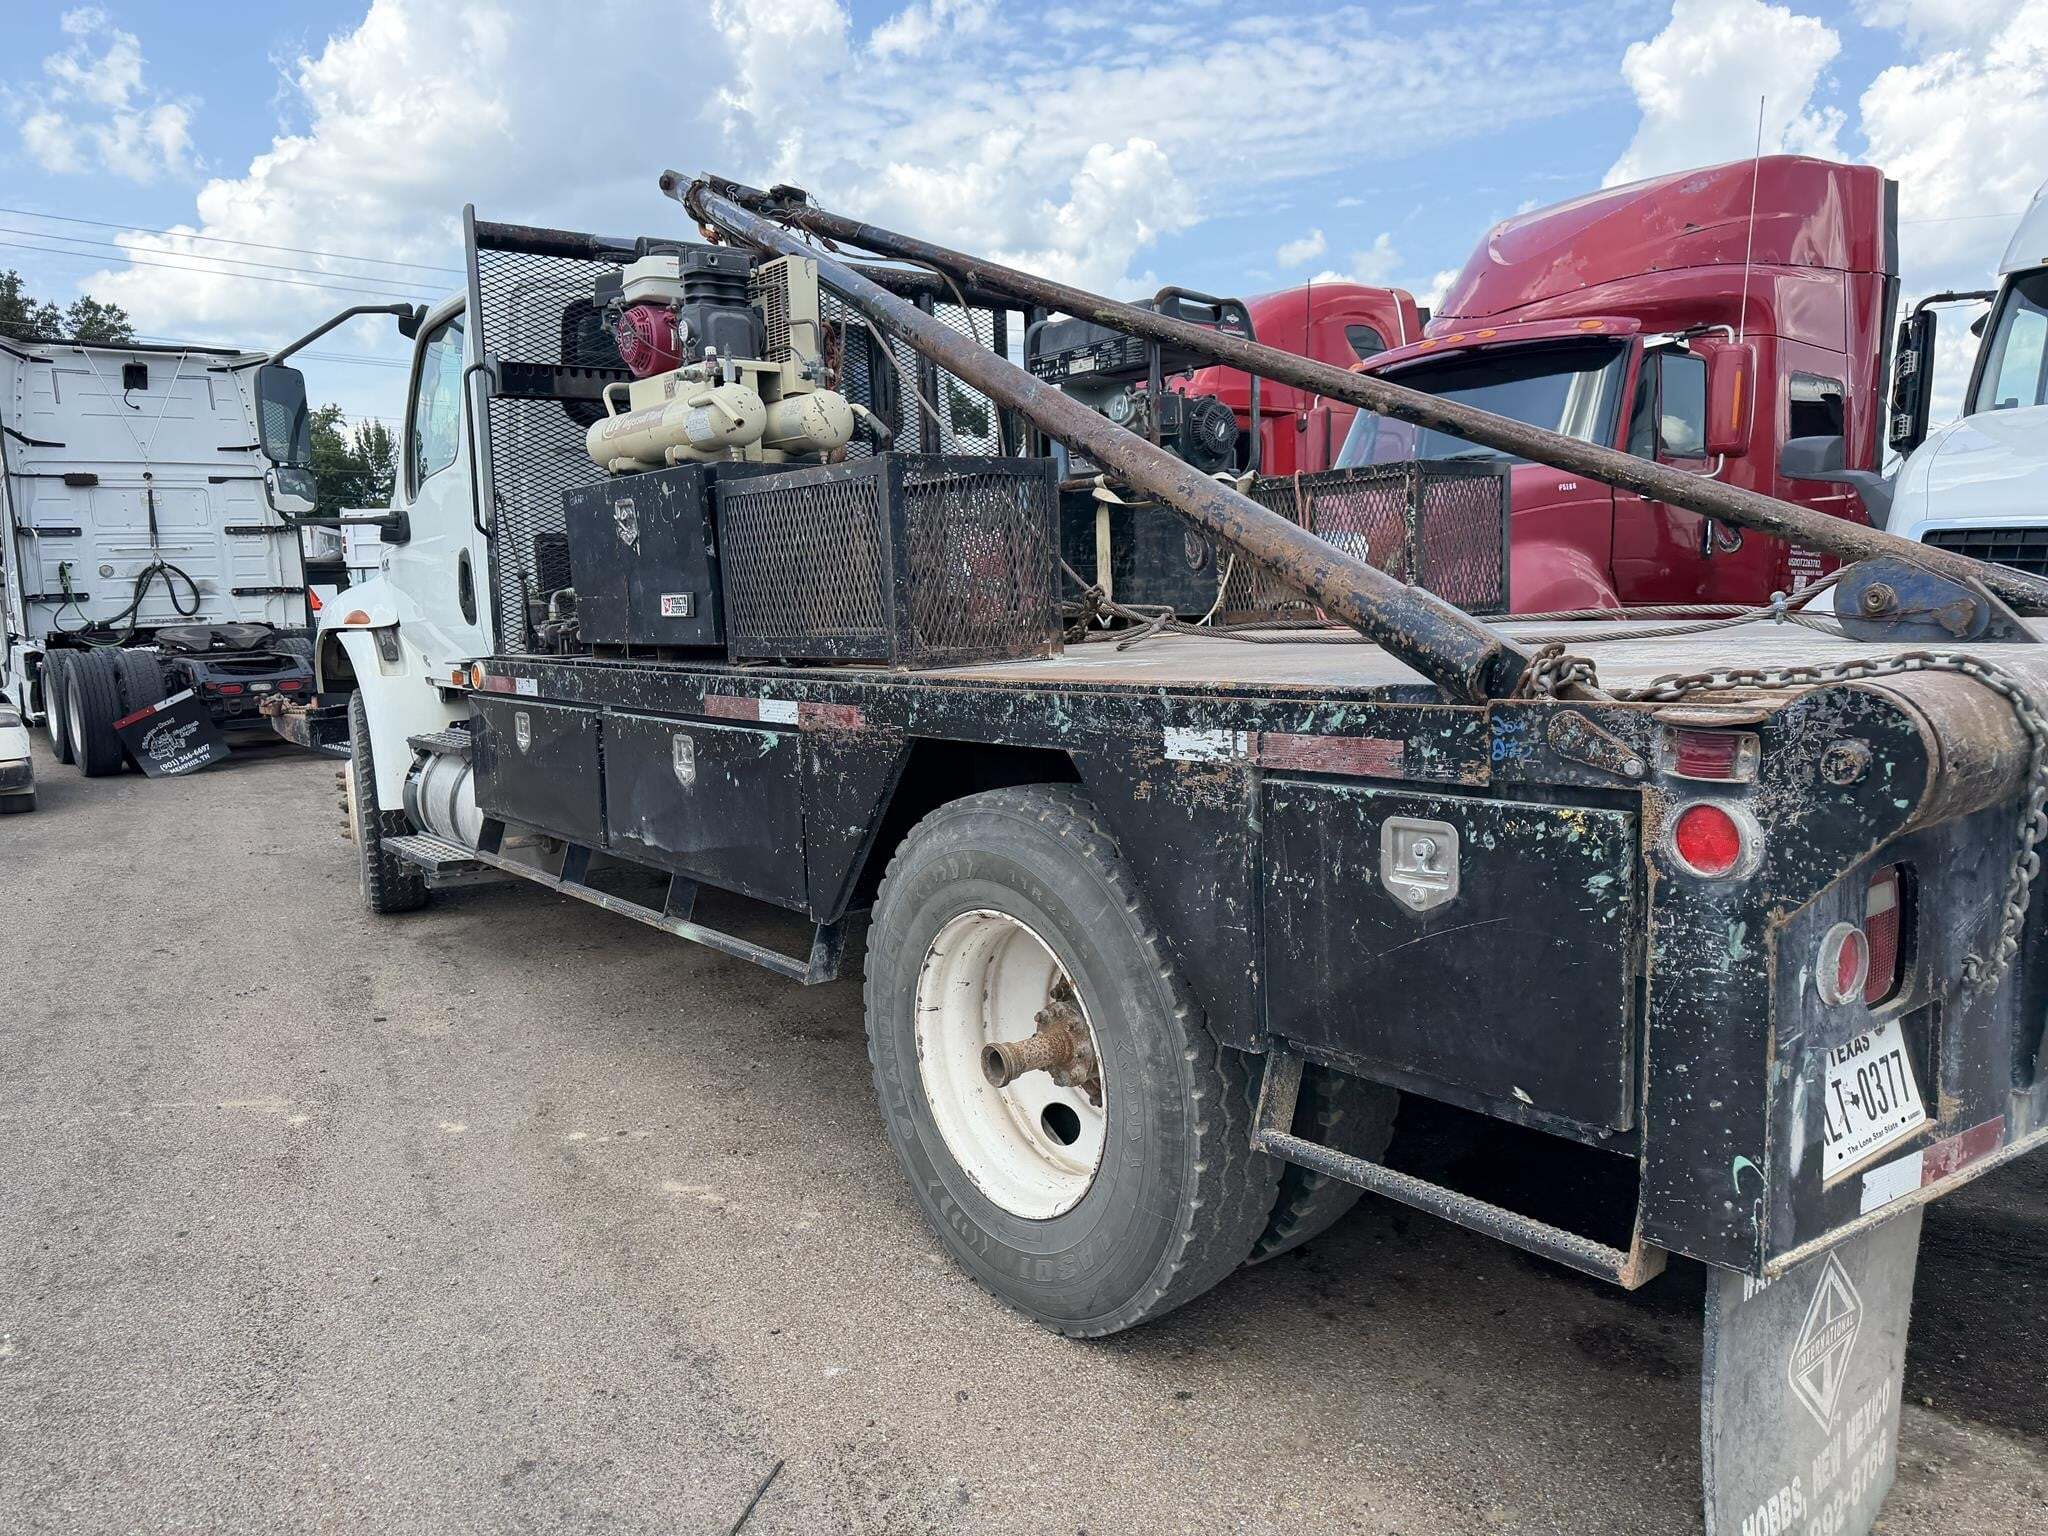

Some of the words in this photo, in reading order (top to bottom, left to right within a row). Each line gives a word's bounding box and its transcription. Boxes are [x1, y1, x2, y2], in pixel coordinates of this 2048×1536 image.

[160, 758, 180, 771] (901)
[1829, 1035, 1870, 1067] TEXAS
[1847, 1142, 1859, 1155] The
[1859, 1135, 1873, 1149] Lone
[1872, 1127, 1885, 1141] Star
[1885, 1122, 1899, 1135] State
[1798, 1316, 1855, 1370] INTERNATIONAL
[1812, 1432, 1841, 1500] NEW
[1846, 1377, 1891, 1459] MEXICO
